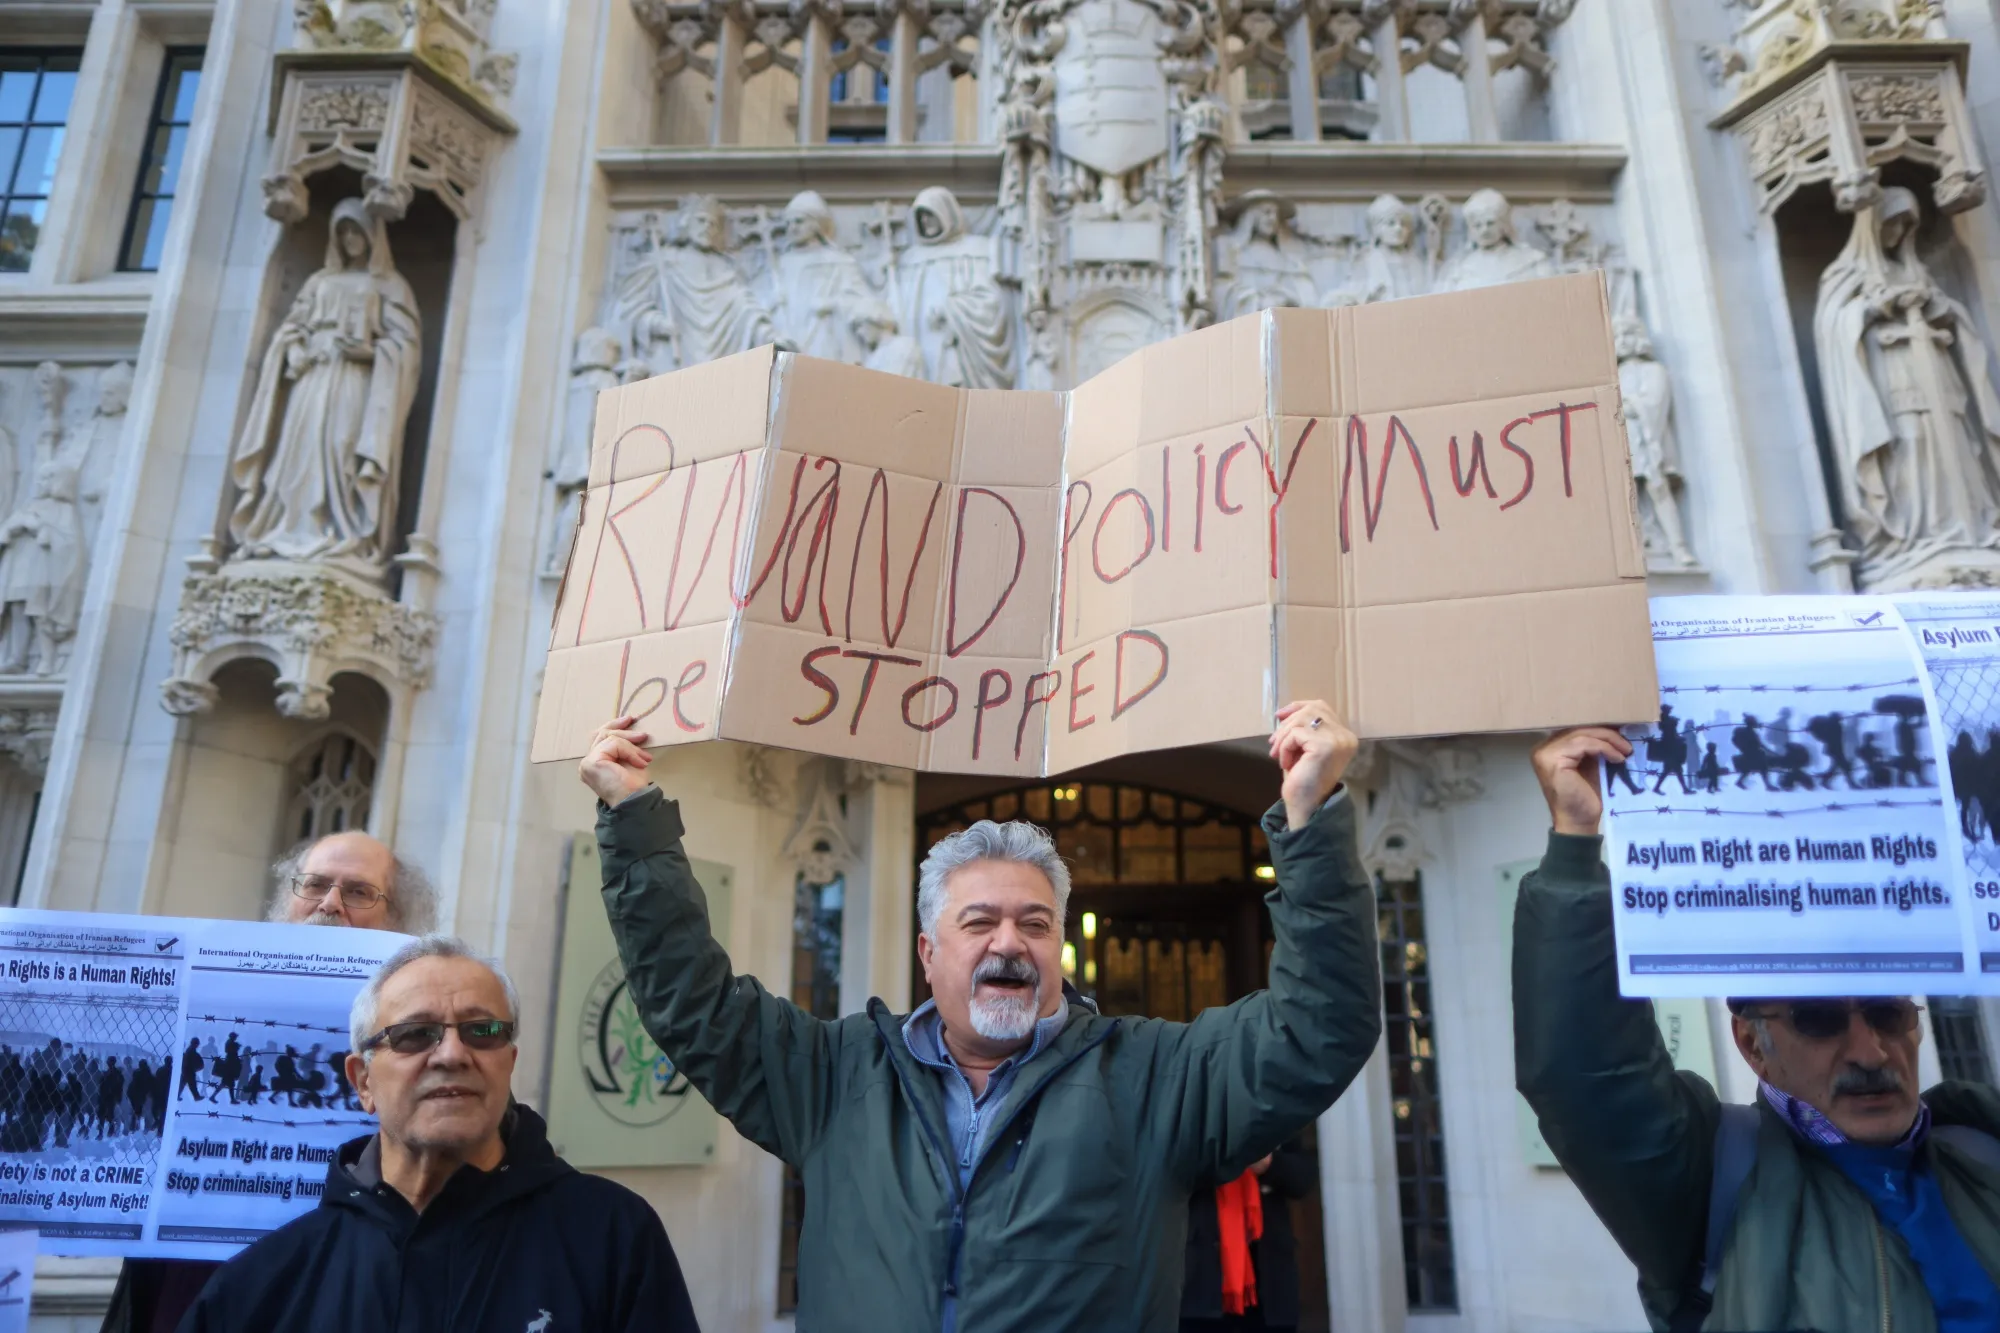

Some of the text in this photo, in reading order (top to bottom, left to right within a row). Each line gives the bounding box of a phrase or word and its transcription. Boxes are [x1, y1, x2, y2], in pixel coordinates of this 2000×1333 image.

[1661, 619, 1729, 627] Organisation
[1732, 617, 1742, 625] of
[1744, 616, 1785, 624] Iranian
[1922, 626, 1993, 649] Asylum
[612, 630, 1169, 762] be STOPPED
[1626, 834, 1937, 871] Asylum Right are Human Rights
[1623, 885, 1668, 914] Stop
[1674, 882, 1803, 913] criminalising
[1807, 881, 1877, 906] human
[1882, 880, 1950, 911] rights.
[0, 929, 146, 944] national Organisation of Iranian Refugees
[198, 947, 383, 966] International Organisation of Iranian Refugees
[8, 959, 50, 984] Rights
[53, 961, 66, 981] is
[68, 966, 77, 982] a
[81, 963, 127, 984] Human
[130, 966, 176, 990] Rights!
[176, 1136, 335, 1164] Asylum Right are Huma
[33, 1162, 47, 1181] is
[50, 1164, 77, 1183] not
[80, 1167, 90, 1183] a
[94, 1165, 145, 1185] CRIME
[166, 1171, 325, 1200] Stop criminalising hum
[57, 1191, 107, 1211] Asylum
[109, 1192, 150, 1213] Right!
